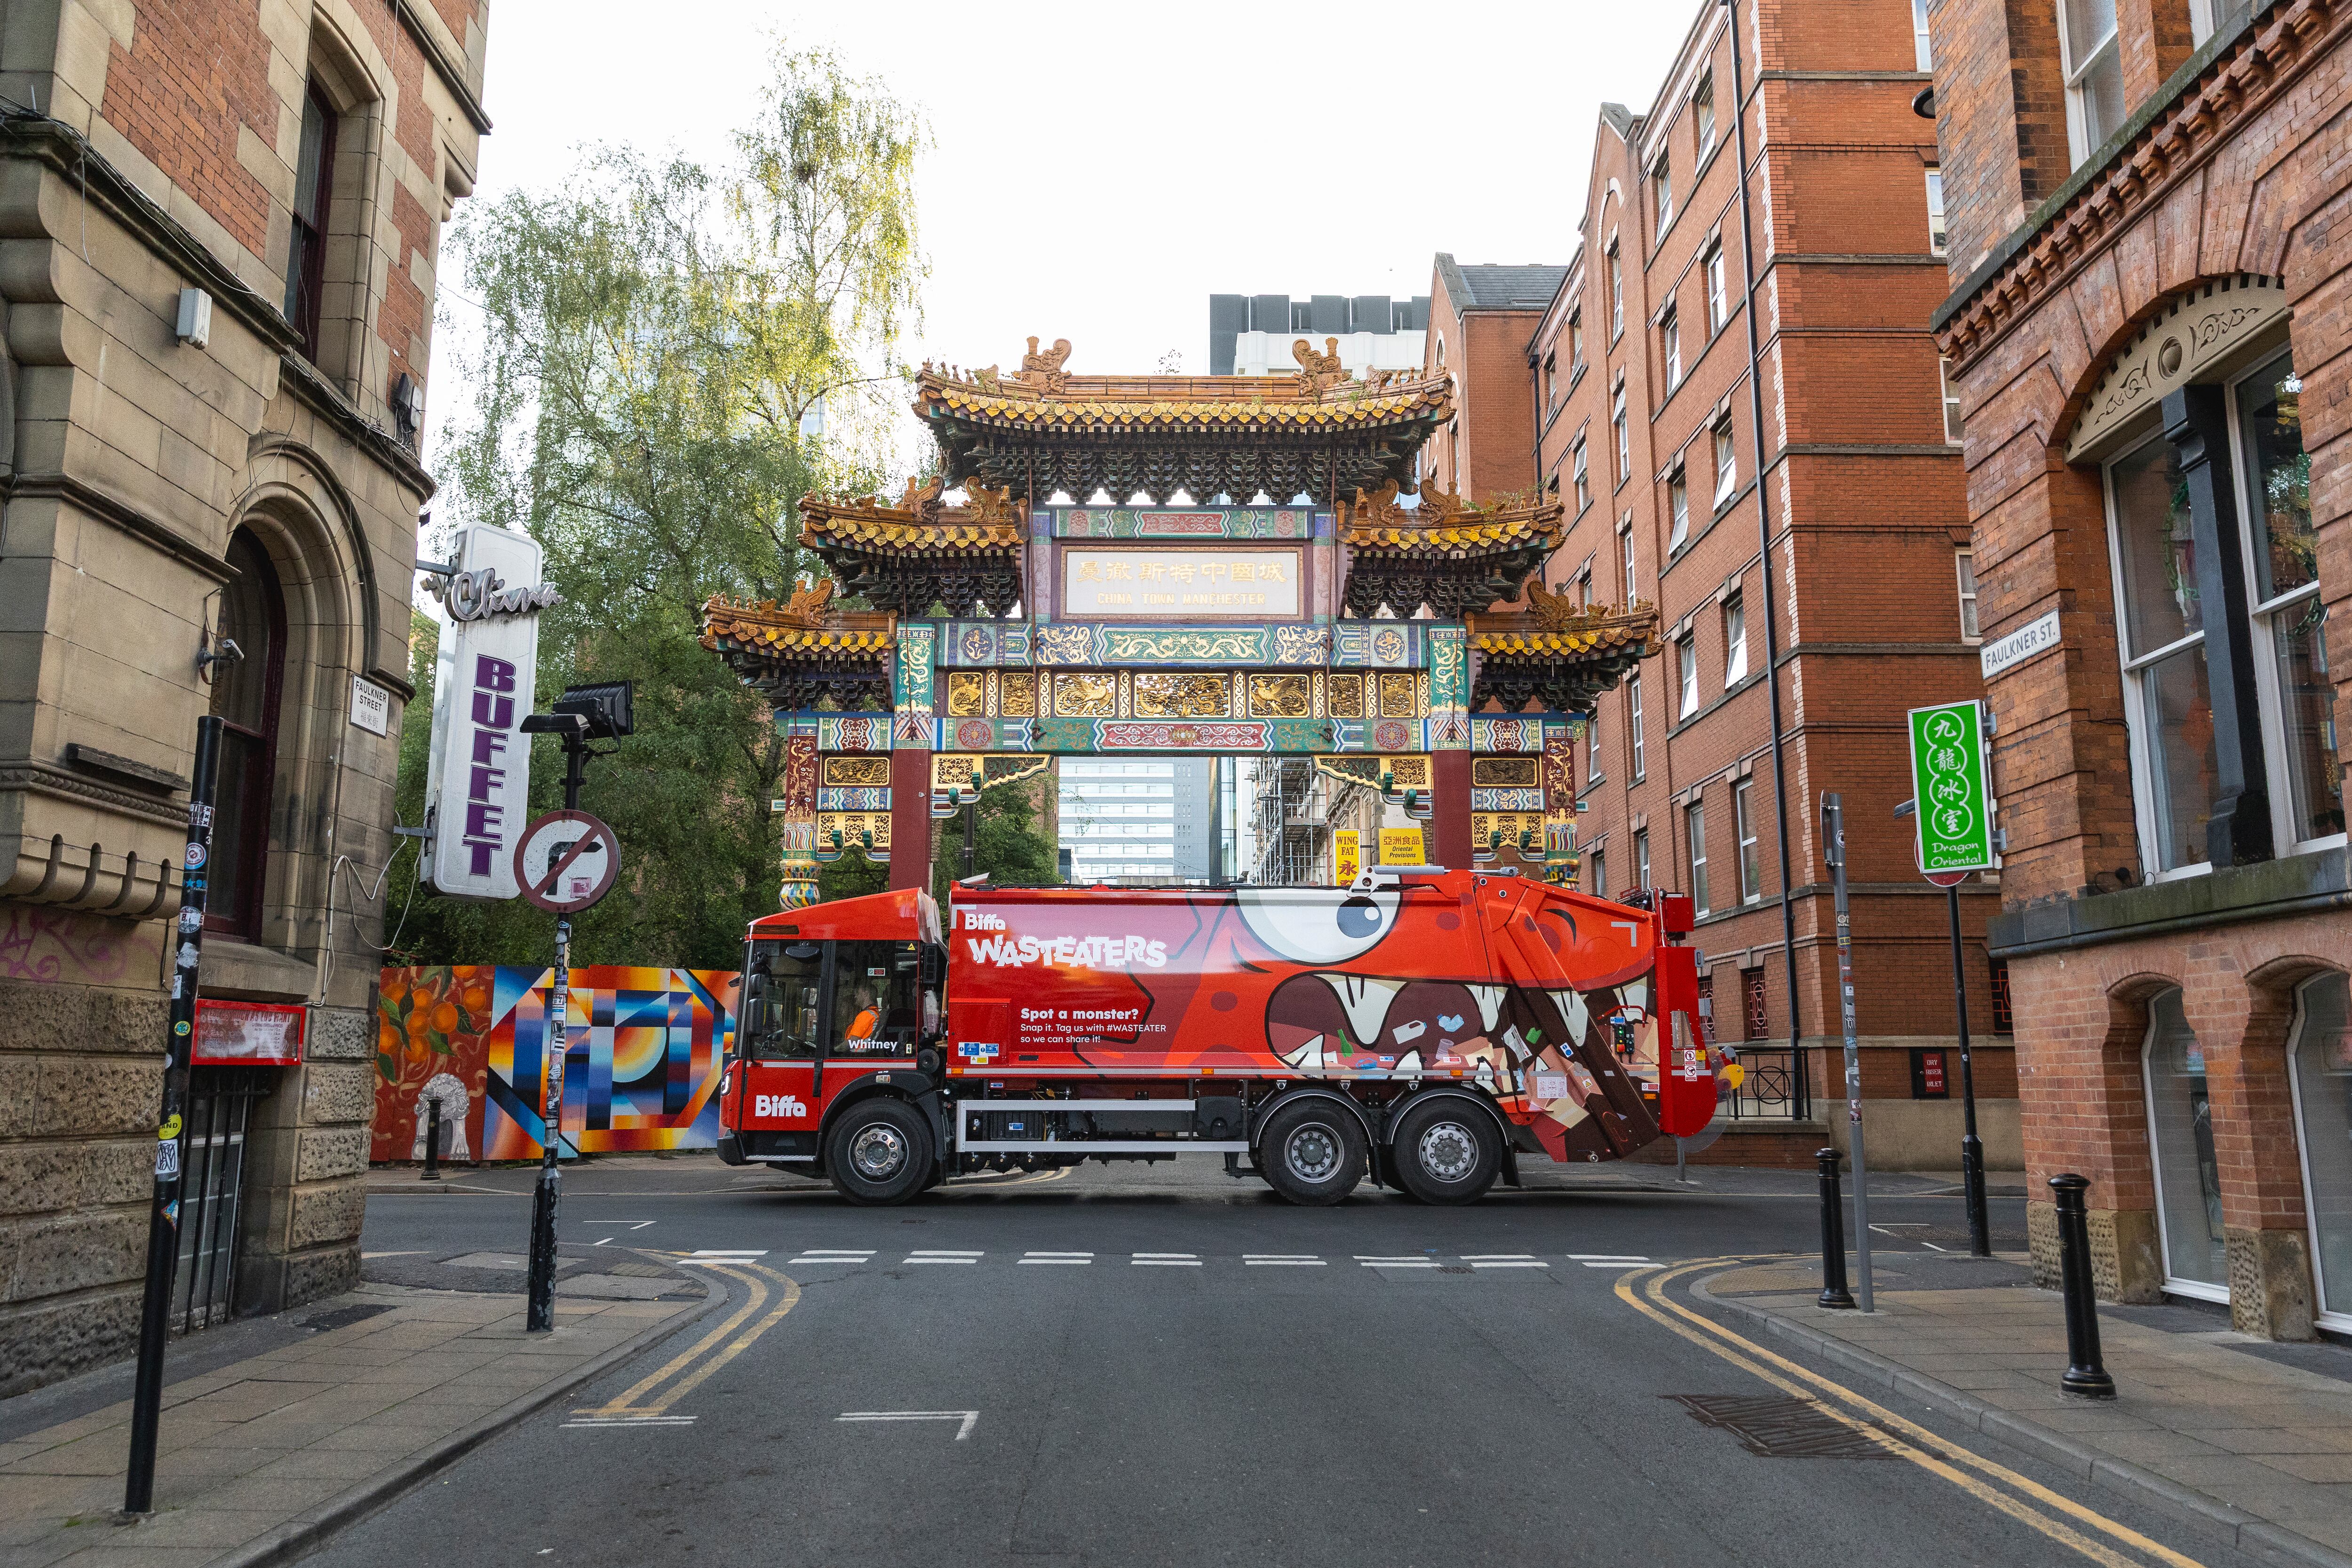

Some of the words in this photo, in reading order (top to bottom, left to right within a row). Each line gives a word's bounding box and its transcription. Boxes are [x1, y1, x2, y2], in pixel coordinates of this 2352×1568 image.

[1076, 561, 1287, 584] 曼徹斯特中國城
[1097, 593, 1132, 605] CHINA
[1142, 593, 1175, 604] TOWN
[1183, 593, 1265, 605] MANCHESTER
[1986, 630, 2037, 669] FAULKNER
[2040, 621, 2055, 641] ST.
[356, 681, 387, 703] FAULKNER
[359, 695, 382, 712] STREET
[461, 653, 516, 876] BUFFET
[1934, 719, 1963, 833] 九龍冰室
[1336, 836, 1358, 845] WING
[1383, 836, 1420, 845] 亞洲食品
[1931, 842, 1979, 854] Dragon
[1931, 853, 1981, 867] Oriental
[965, 913, 1006, 930] Biffa
[967, 934, 1167, 967] WASTEATERS
[1021, 1008, 1054, 1022] Spot
[1058, 1010, 1067, 1019] a
[1073, 1009, 1138, 1019] monster?
[1020, 1024, 1043, 1033] Snap
[1056, 1024, 1071, 1033] Tag
[848, 1038, 898, 1052] Whitney
[755, 1095, 806, 1117] Biffa
